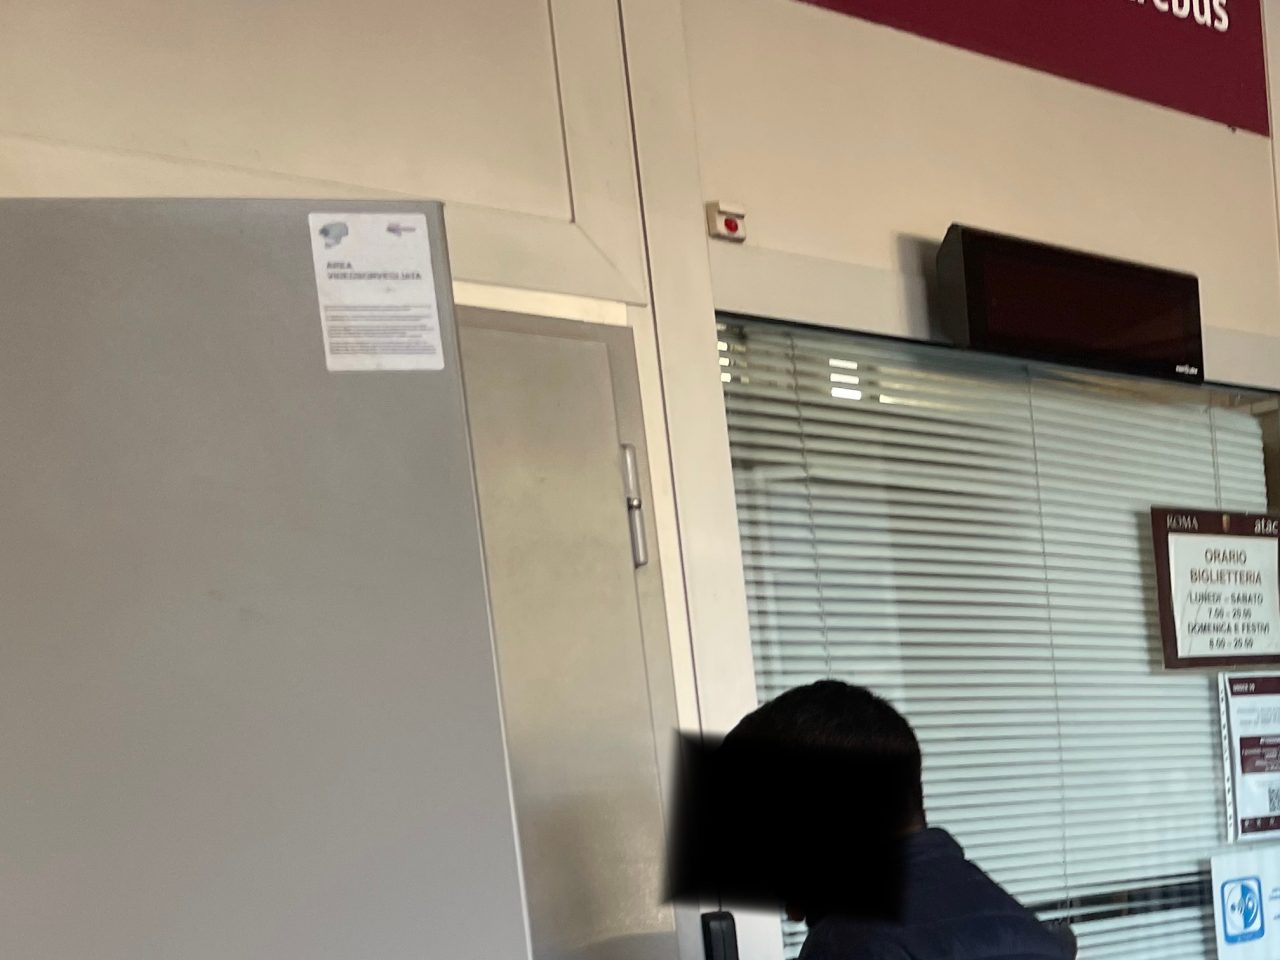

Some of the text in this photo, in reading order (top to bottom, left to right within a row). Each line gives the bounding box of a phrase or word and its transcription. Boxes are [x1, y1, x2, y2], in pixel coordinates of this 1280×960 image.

[1166, 513, 1279, 534] ROMA atac
[1204, 548, 1248, 565] ORARIO
[1190, 569, 1262, 585] BIGLIETTERIA
